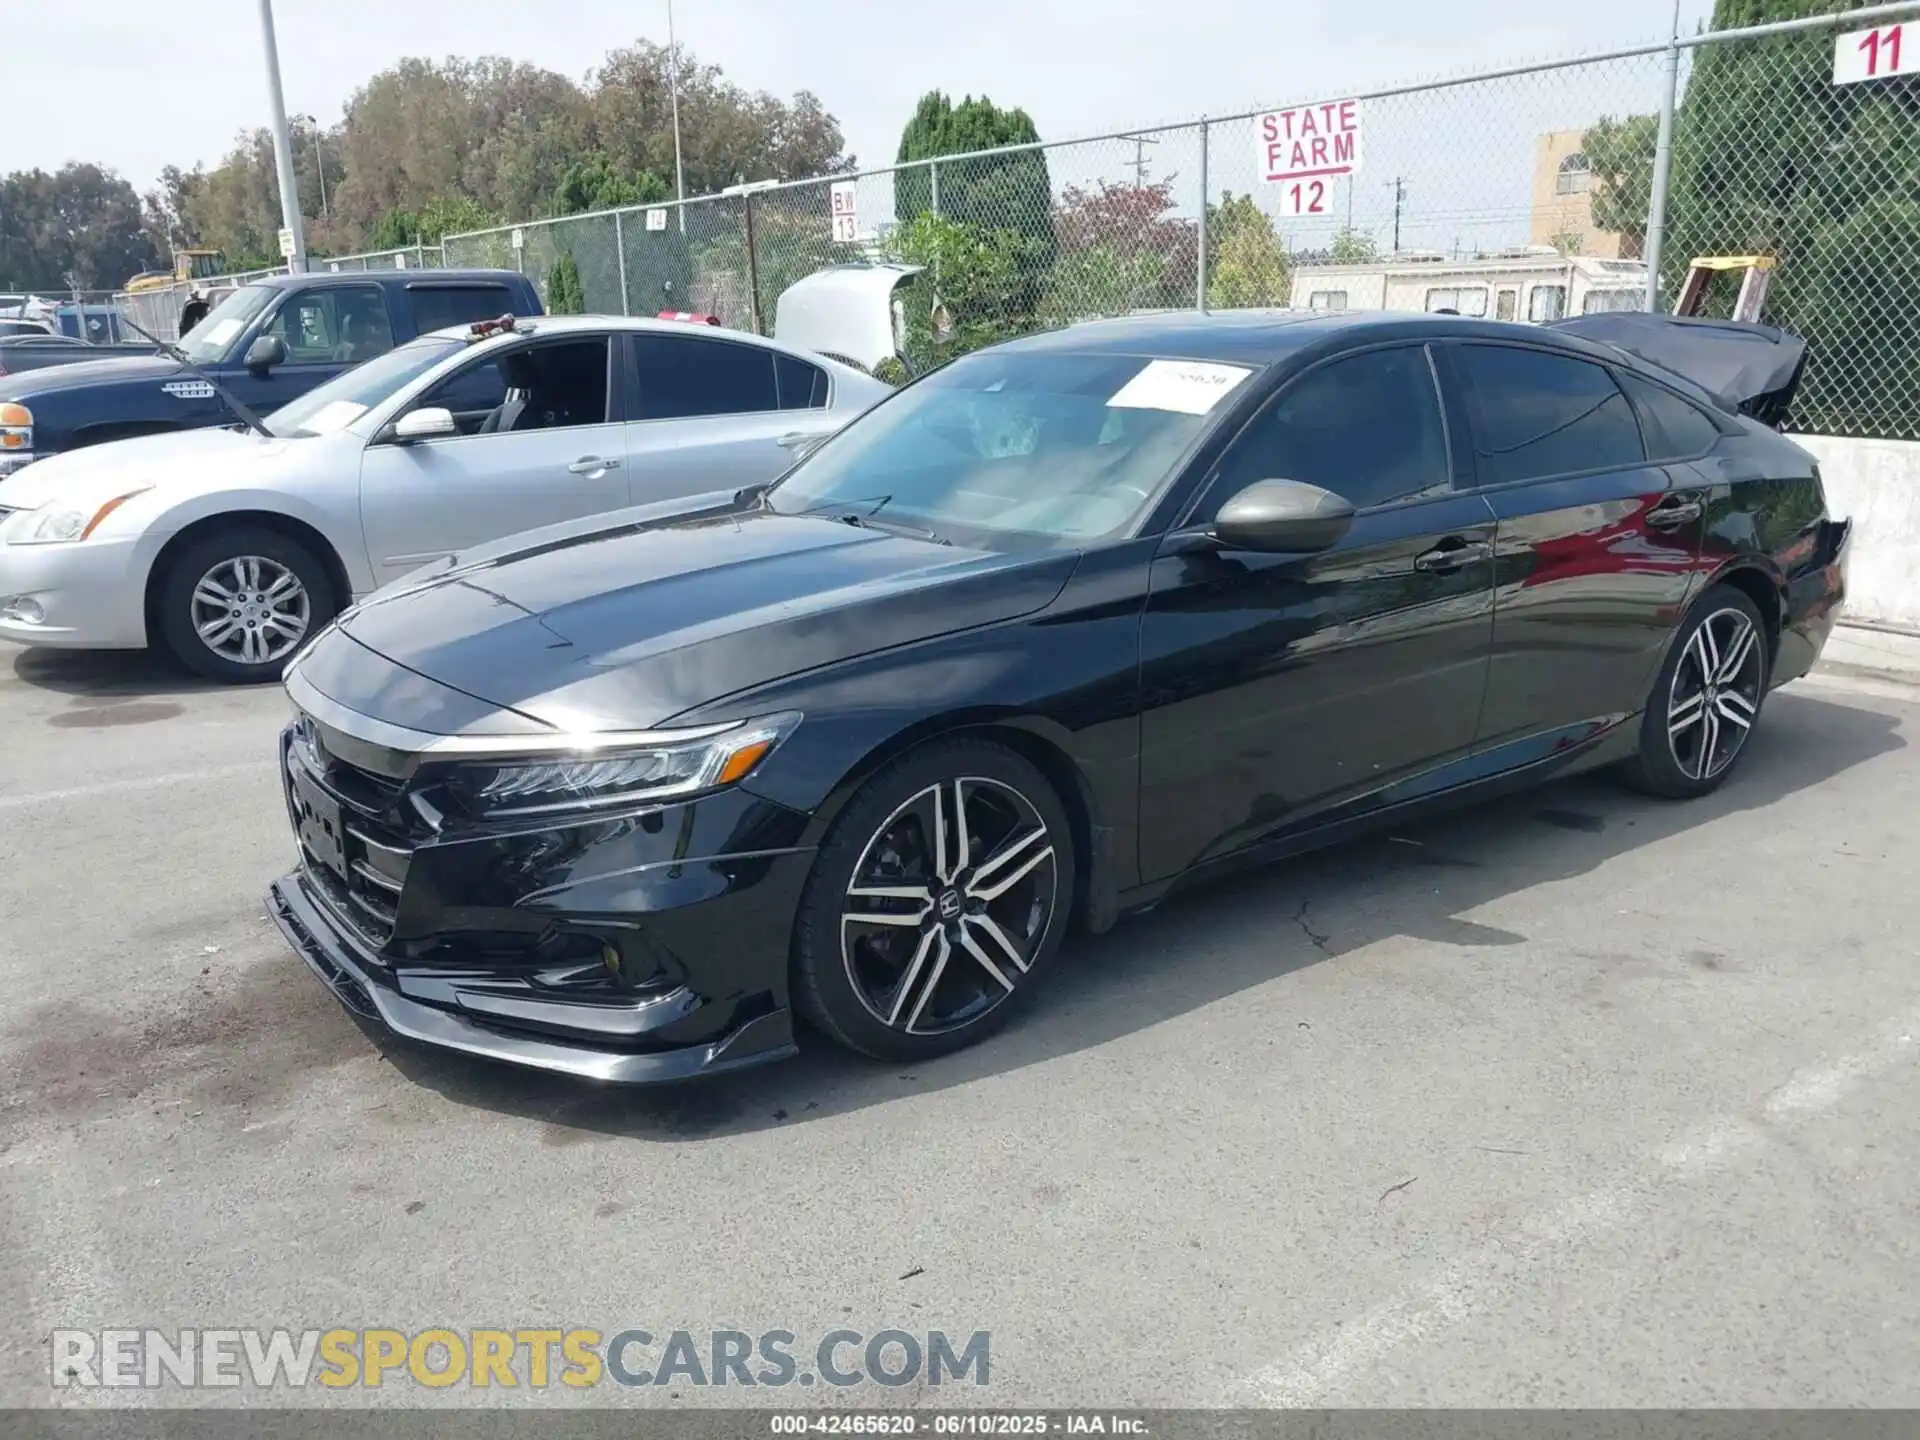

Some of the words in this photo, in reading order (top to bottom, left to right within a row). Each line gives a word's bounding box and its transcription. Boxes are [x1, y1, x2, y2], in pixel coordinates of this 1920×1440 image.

[1858, 24, 1902, 76] 11
[1262, 100, 1358, 142] STATE
[1267, 131, 1355, 171] FARM
[1289, 180, 1325, 214] 12
[838, 217, 856, 239] 13
